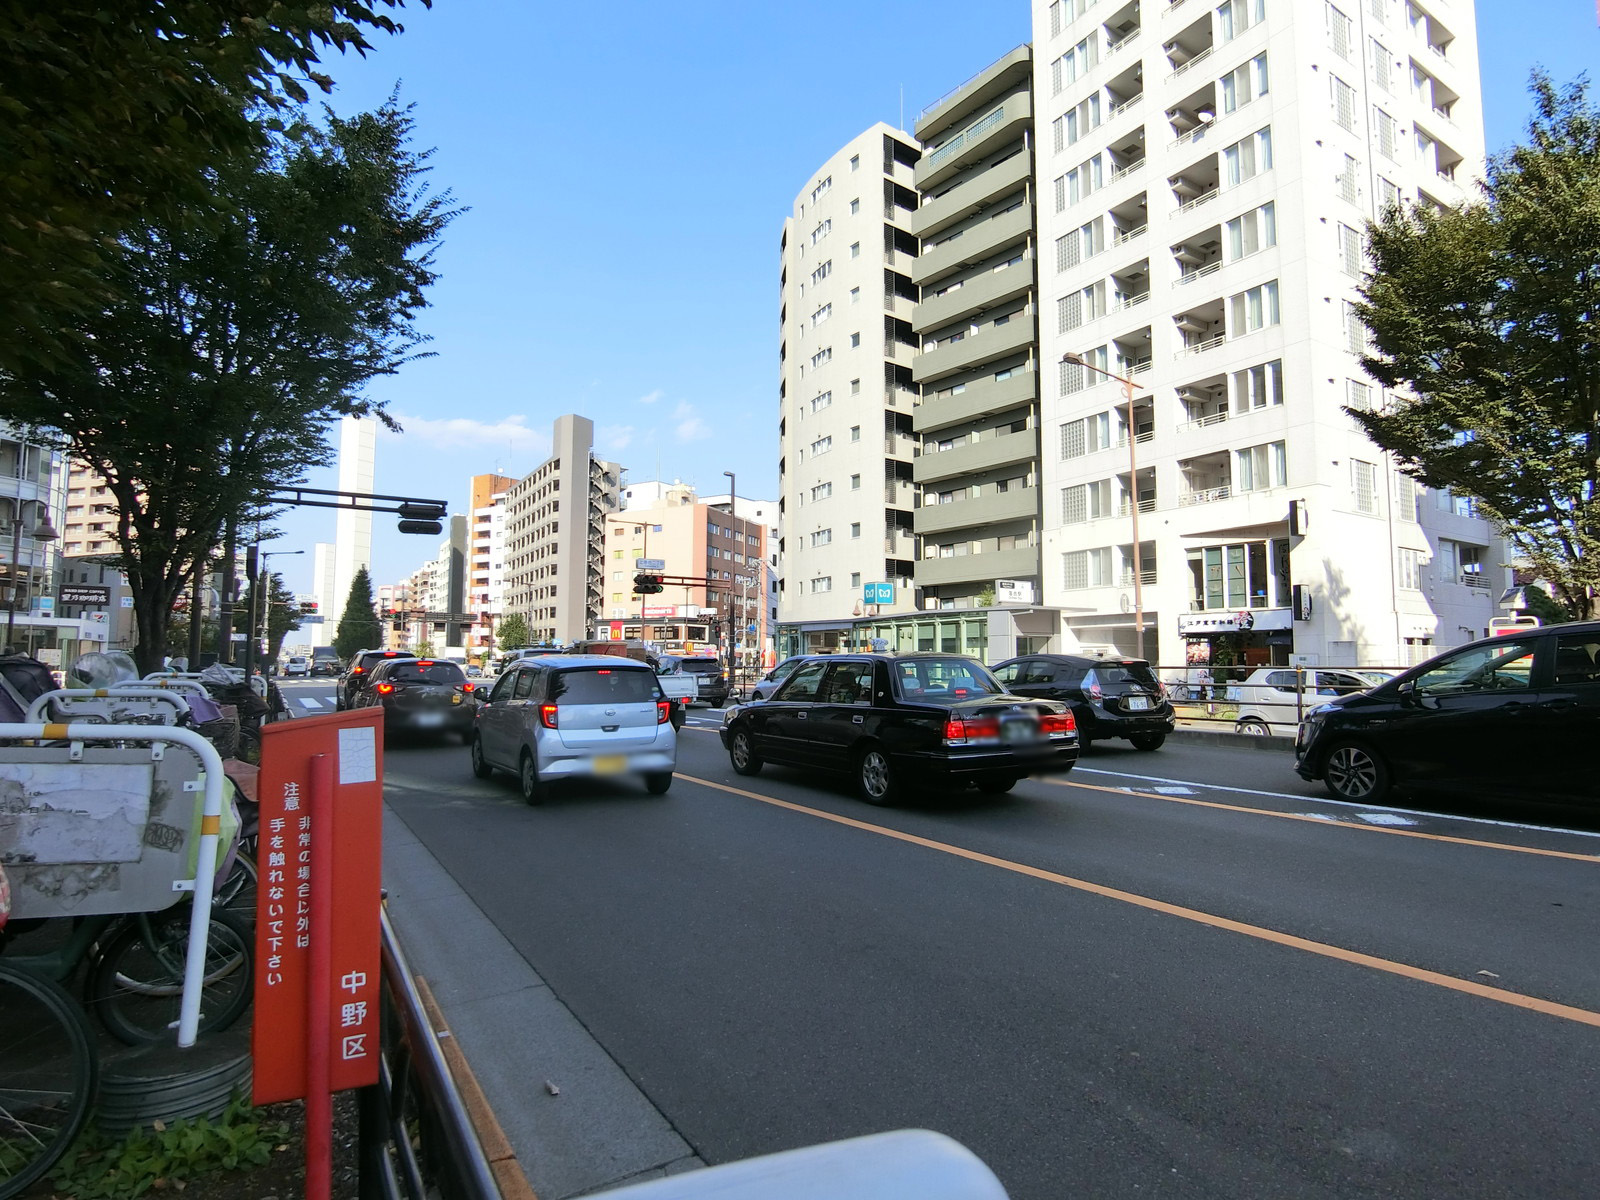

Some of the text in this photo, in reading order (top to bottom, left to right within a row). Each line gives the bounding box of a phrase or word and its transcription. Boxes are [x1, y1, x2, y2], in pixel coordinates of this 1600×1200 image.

[284, 782, 300, 811] 注意
[267, 817, 286, 986] 手を触れないで下さい
[341, 970, 367, 1060] 中野区
